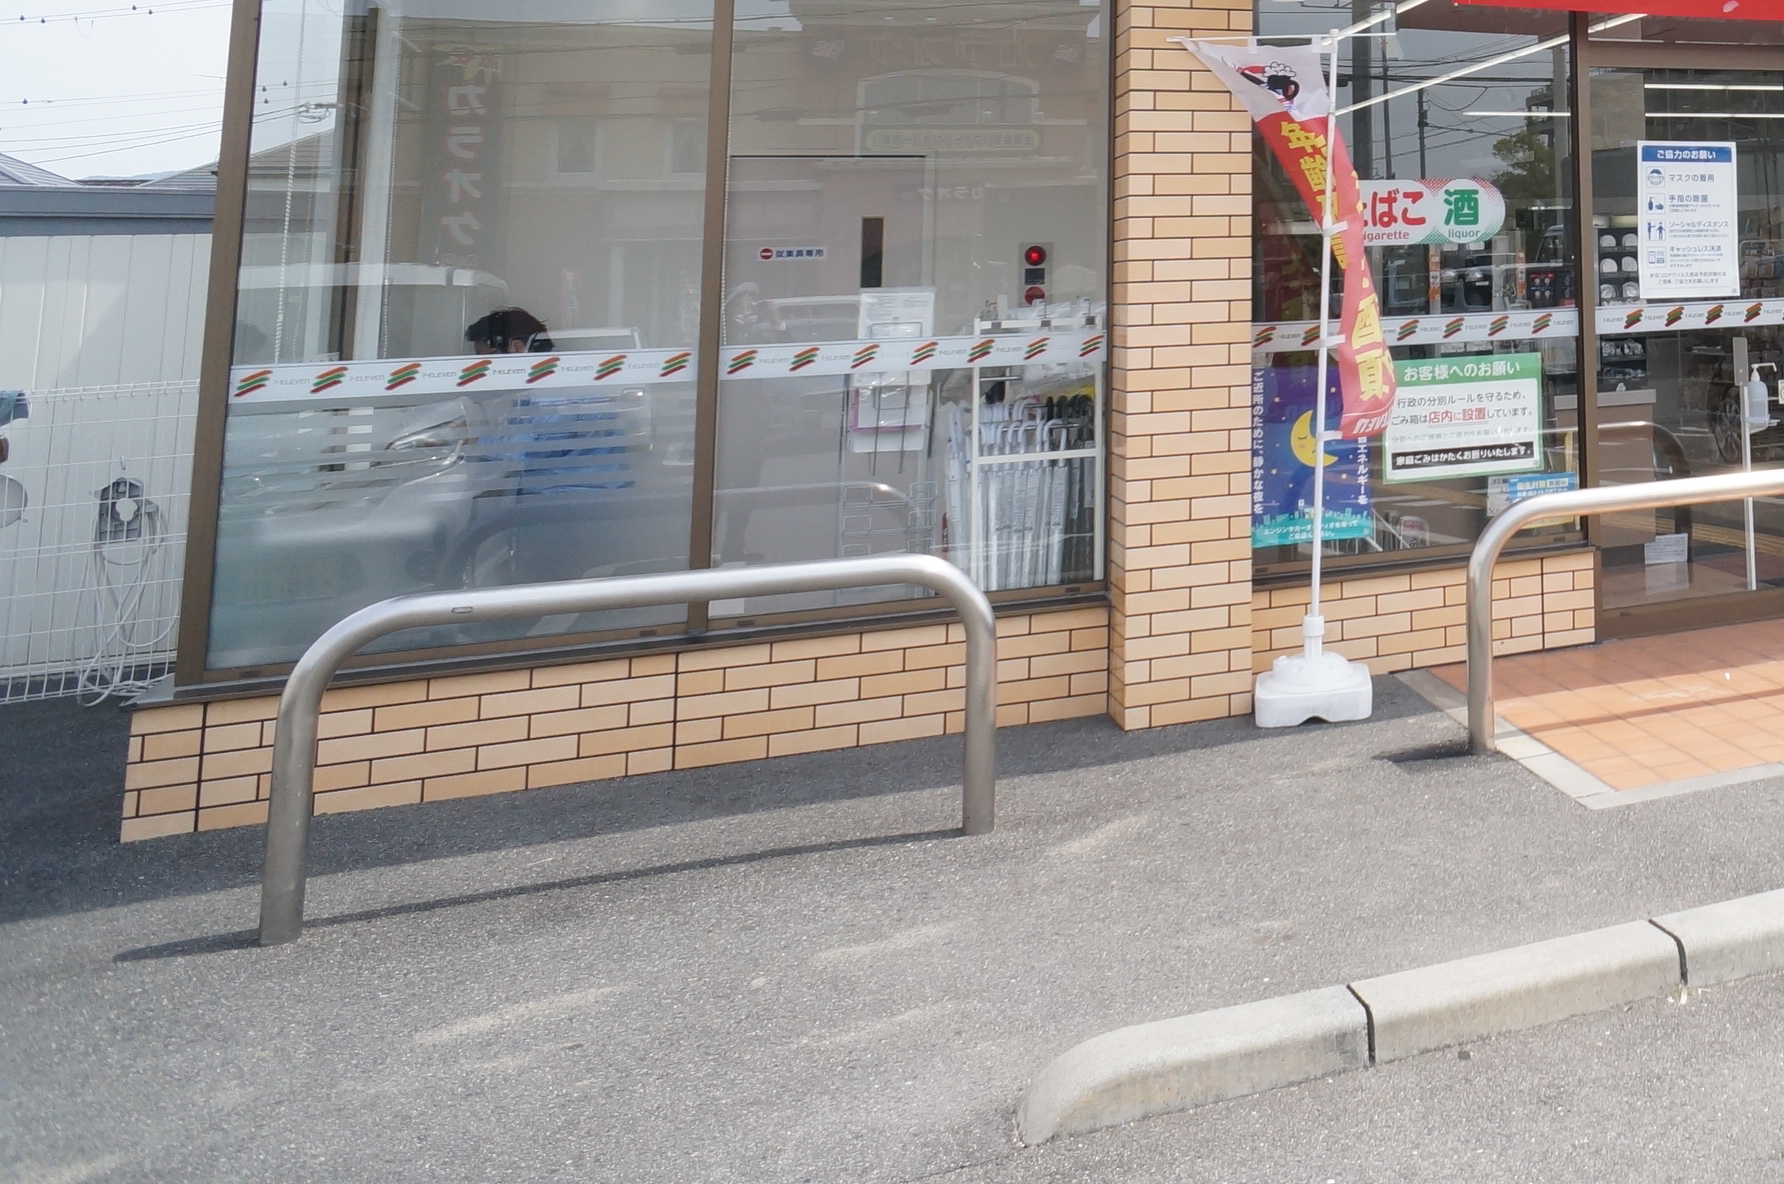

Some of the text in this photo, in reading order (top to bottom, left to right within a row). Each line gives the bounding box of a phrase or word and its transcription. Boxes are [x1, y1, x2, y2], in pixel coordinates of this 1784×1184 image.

[1657, 149, 1716, 159] ご協力のお願い
[1669, 174, 1715, 182] マスクの着用
[1444, 189, 1479, 226] 酒
[1669, 194, 1709, 203] 手指の除菌
[1363, 228, 1481, 241] igarette liquor
[1404, 360, 1520, 382] お客様へのお願い
[1398, 391, 1526, 409] 行政の分別ルールを守るため、
[1392, 407, 1533, 426] ごみ箱は店内に設置しています。
[1252, 370, 1265, 514] ご近所のために、静かな夜を
[1396, 445, 1531, 466] 家庭ごみはかたくお断りいたします。
